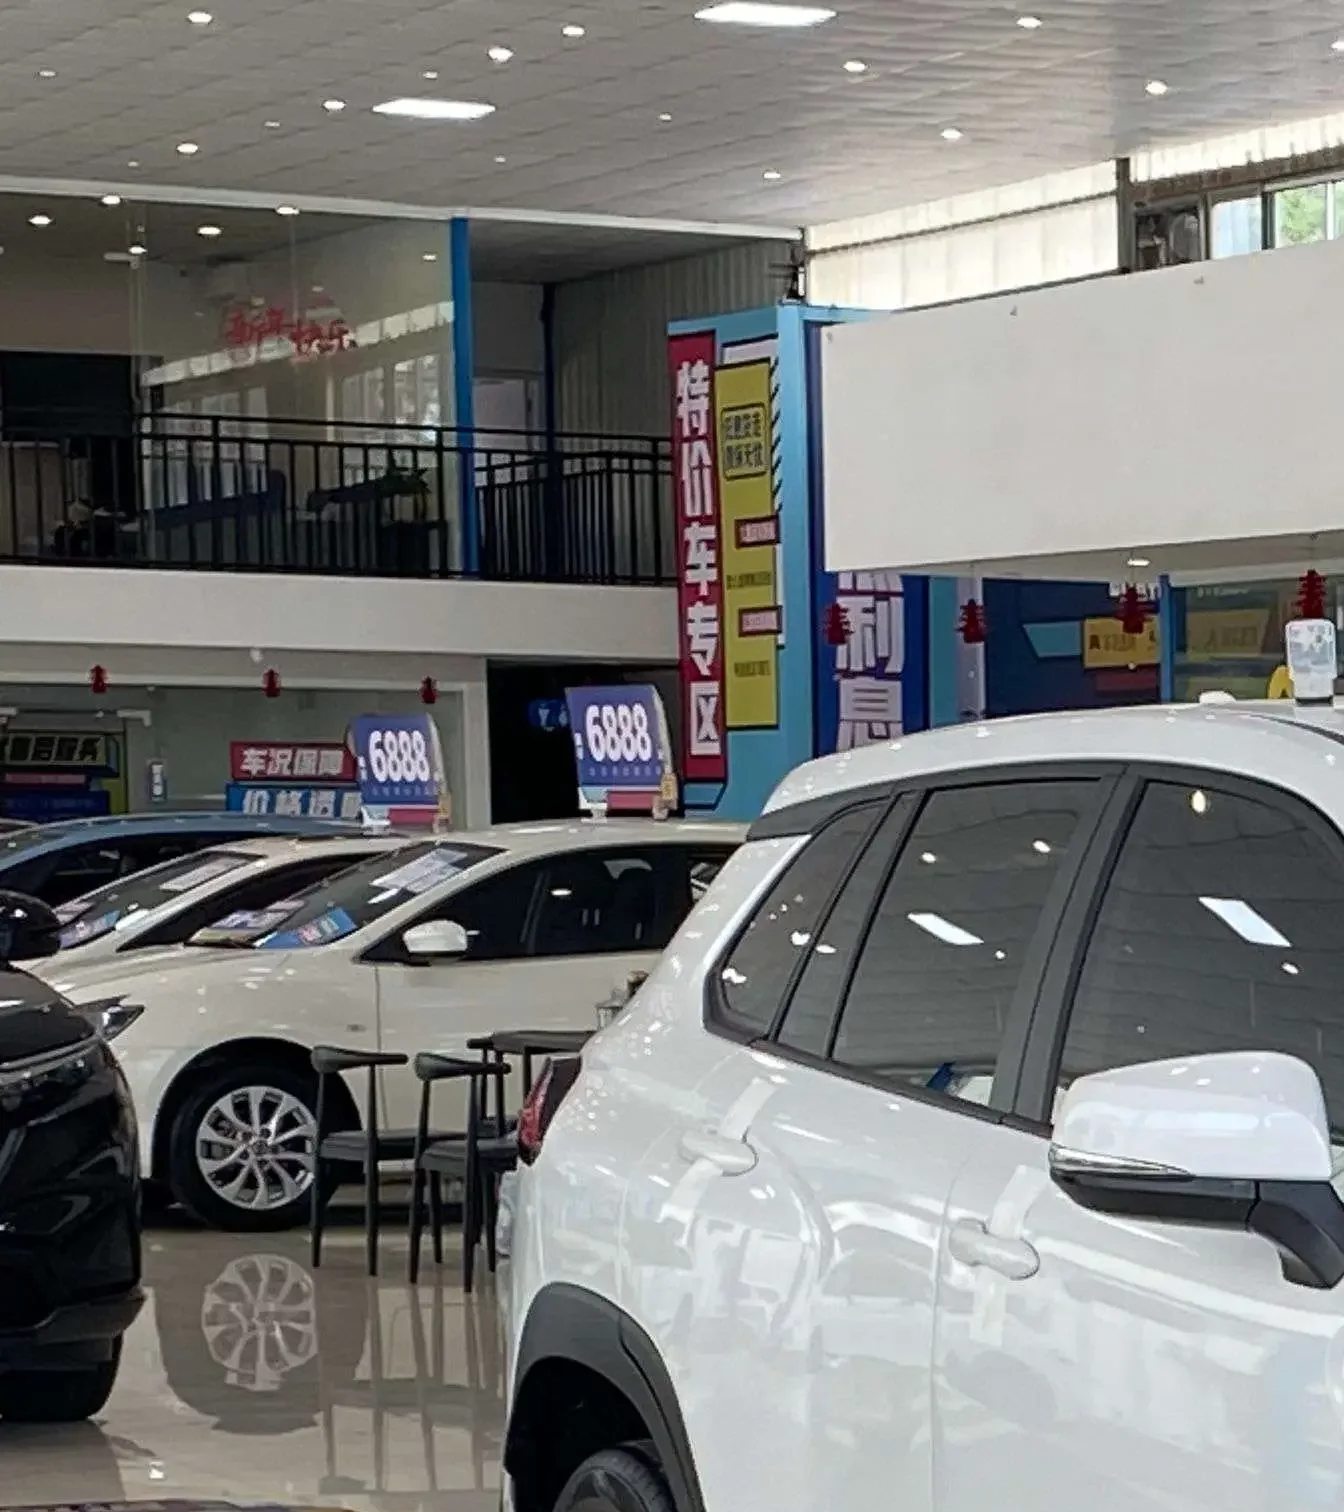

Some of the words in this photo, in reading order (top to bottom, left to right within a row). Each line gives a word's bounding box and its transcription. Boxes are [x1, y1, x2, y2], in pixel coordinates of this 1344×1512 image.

[677, 359, 722, 756] 特价车专区
[368, 729, 431, 783] 6888
[586, 703, 652, 762] 6888
